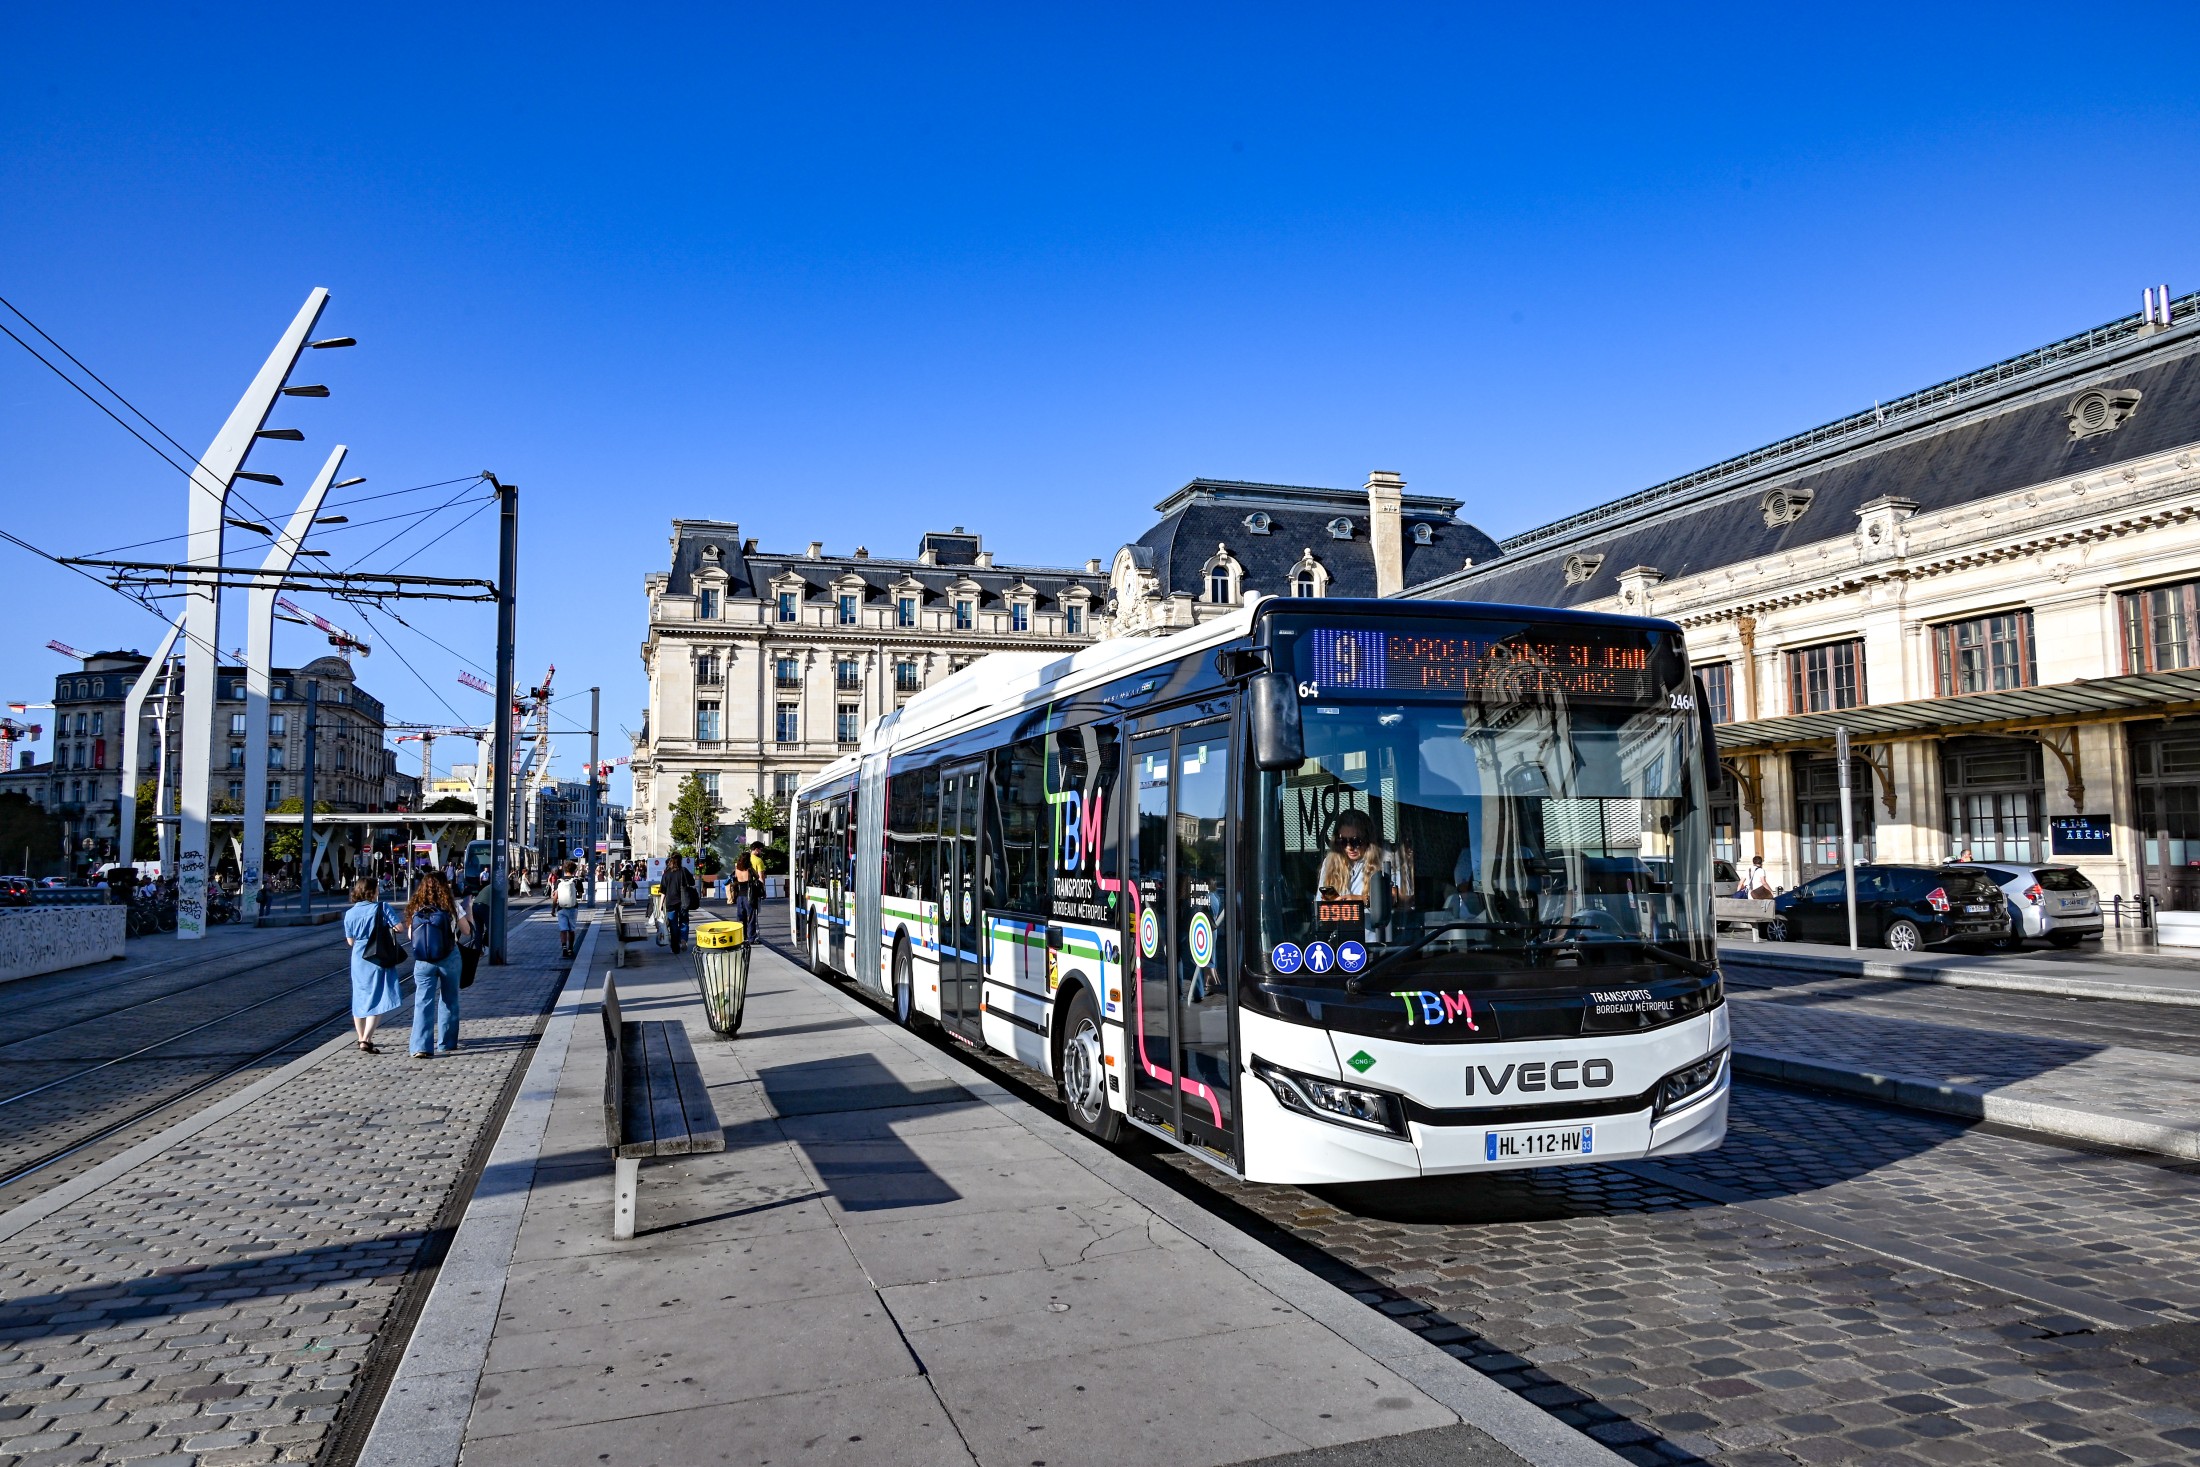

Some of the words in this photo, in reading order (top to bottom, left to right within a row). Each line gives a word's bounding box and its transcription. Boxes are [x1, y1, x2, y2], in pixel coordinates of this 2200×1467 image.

[1336, 634, 1360, 683] 9
[1669, 693, 1695, 710] 2464
[1050, 787, 1103, 871] TBM
[1054, 878, 1092, 899] TRANSPORTS
[1053, 901, 1077, 917] BORDEAUX
[1077, 900, 1108, 921] MÉTROPOLE
[1319, 904, 1360, 921] 0901
[1590, 989, 1652, 1003] TRANSPORTS
[1390, 989, 1479, 1031] TBM
[1596, 1003, 1633, 1014] BORDEAUX
[1635, 1000, 1674, 1012] MÉTROPOLE
[1465, 1058, 1613, 1096] IVECO
[1582, 1140, 1591, 1150] 33
